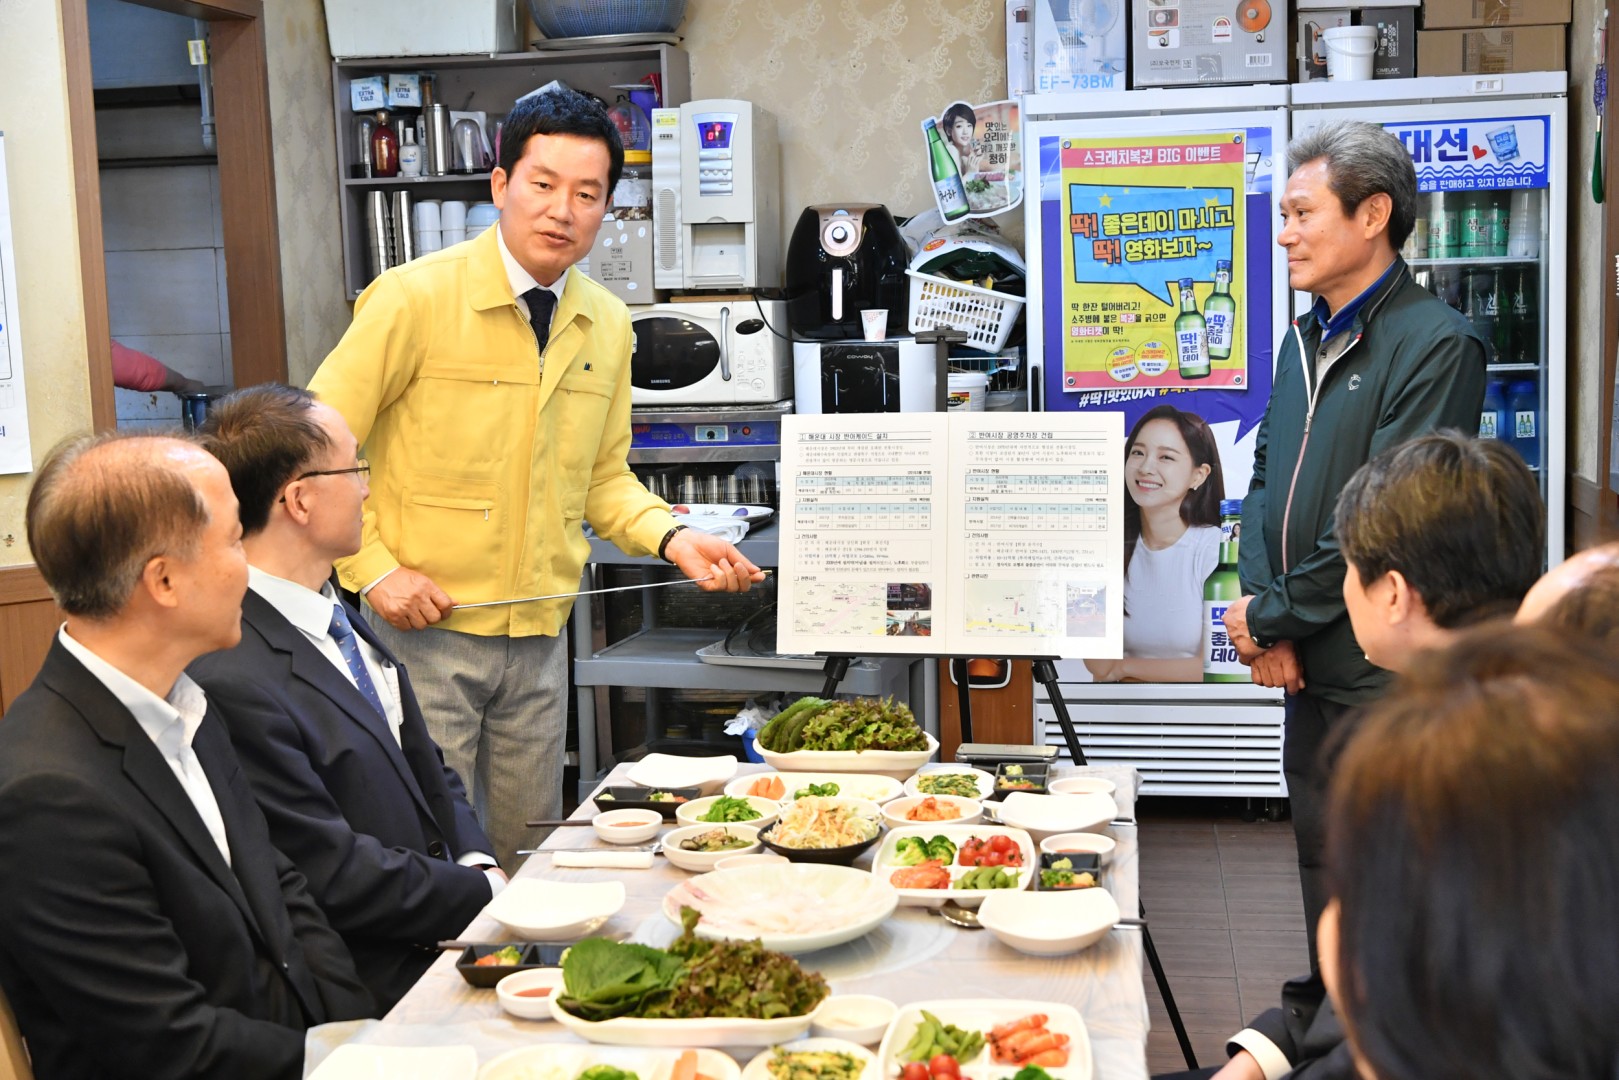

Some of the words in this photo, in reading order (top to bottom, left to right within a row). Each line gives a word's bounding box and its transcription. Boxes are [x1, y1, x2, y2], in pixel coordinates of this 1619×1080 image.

[1039, 74, 1114, 89] EF-73BM
[1084, 149, 1153, 166] 스크래치복권
[1157, 148, 1181, 163] BIG
[1185, 146, 1221, 162] 이벤트
[1440, 179, 1475, 190] 판매하고
[1477, 178, 1495, 188] 있지
[1497, 176, 1534, 187] 않습니다.
[1070, 213, 1099, 238] 딱!
[1103, 210, 1175, 236] 좋은데이
[1178, 205, 1234, 231] 마시고
[1093, 239, 1122, 264] 딱!
[1125, 235, 1213, 262] 영화보자~
[1071, 303, 1079, 311] 딱
[1082, 302, 1098, 311] 한잔
[1071, 314, 1100, 324] 소주병에
[1112, 326, 1124, 335] 딱!
[1180, 332, 1198, 345] 딱!
[1182, 353, 1199, 362] 데이
